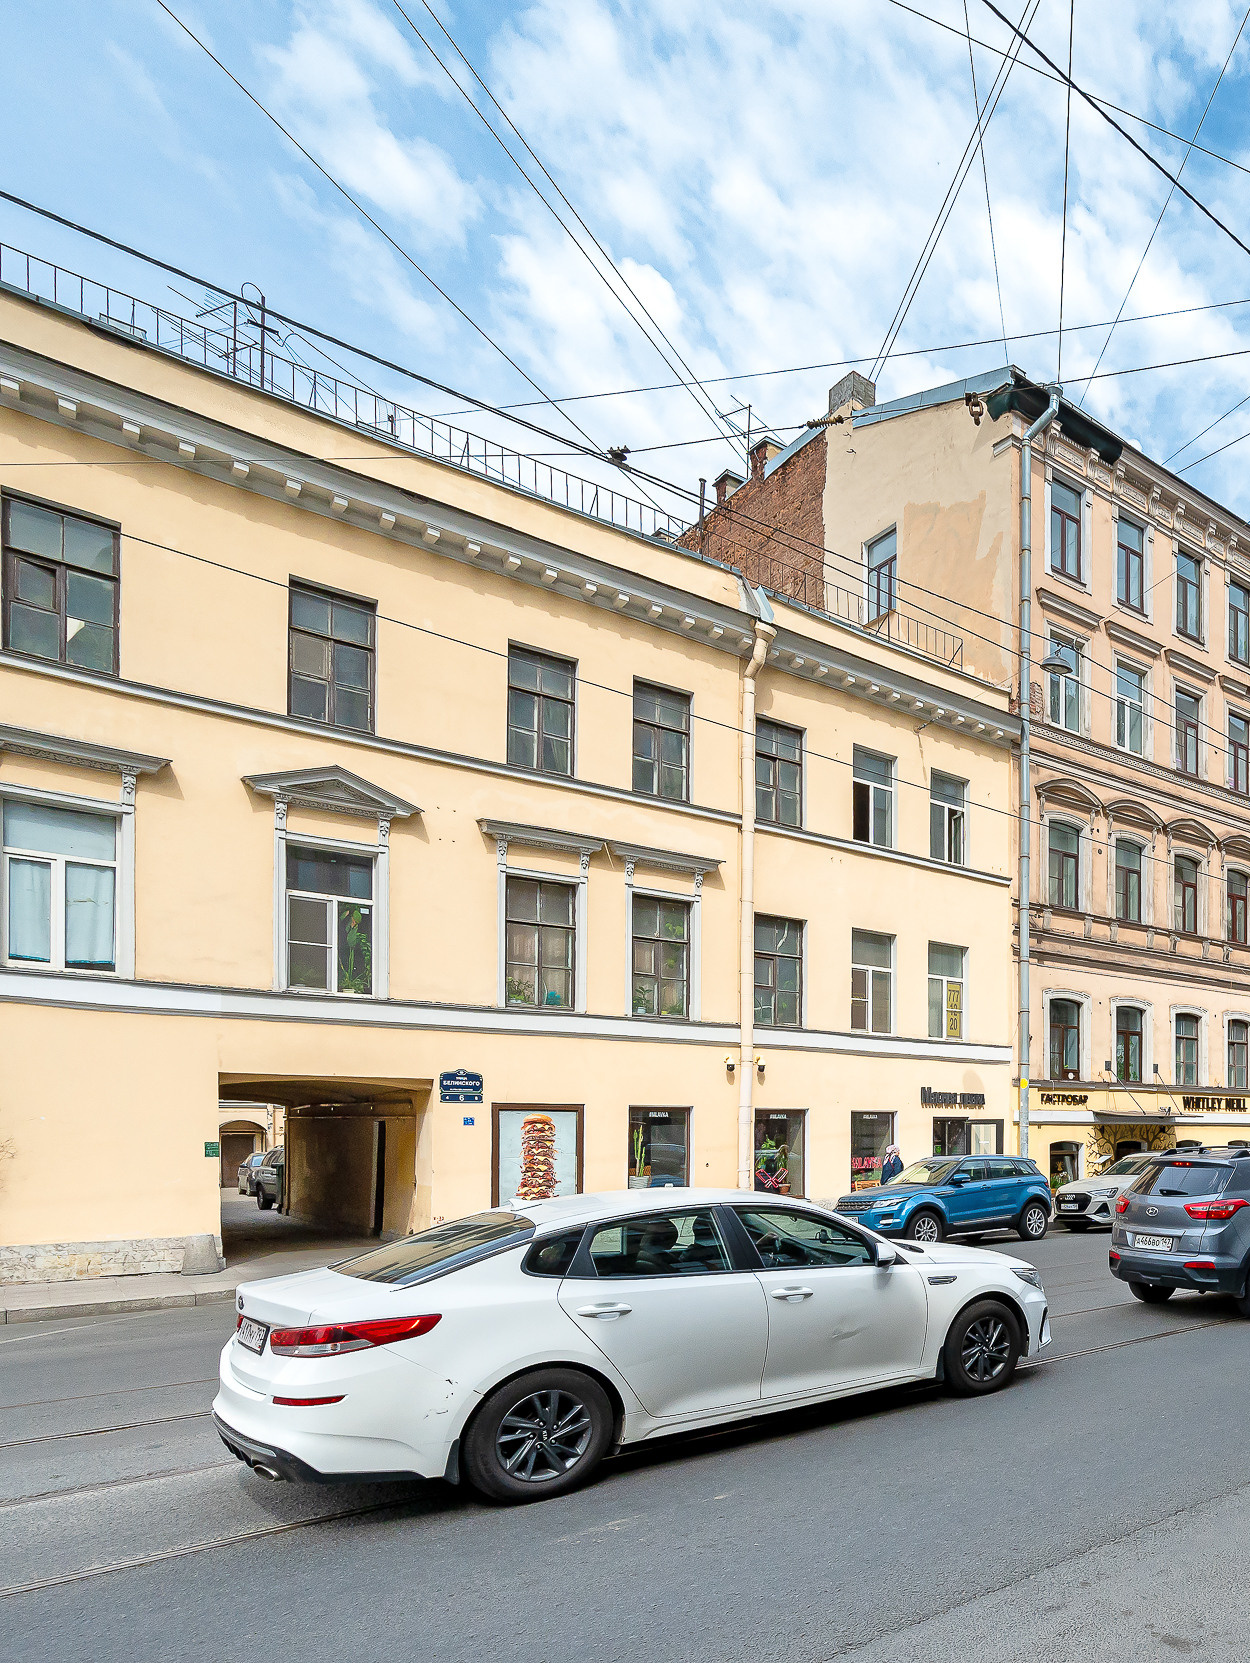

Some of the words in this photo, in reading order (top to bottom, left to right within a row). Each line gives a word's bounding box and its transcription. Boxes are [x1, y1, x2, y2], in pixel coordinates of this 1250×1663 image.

[948, 989, 960, 1002] 777
[949, 1017, 958, 1031] 20
[1040, 1093, 1088, 1104] ГАСТРОБАР
[1182, 1096, 1223, 1110] WHITLEY
[1224, 1098, 1248, 1111] NEILL
